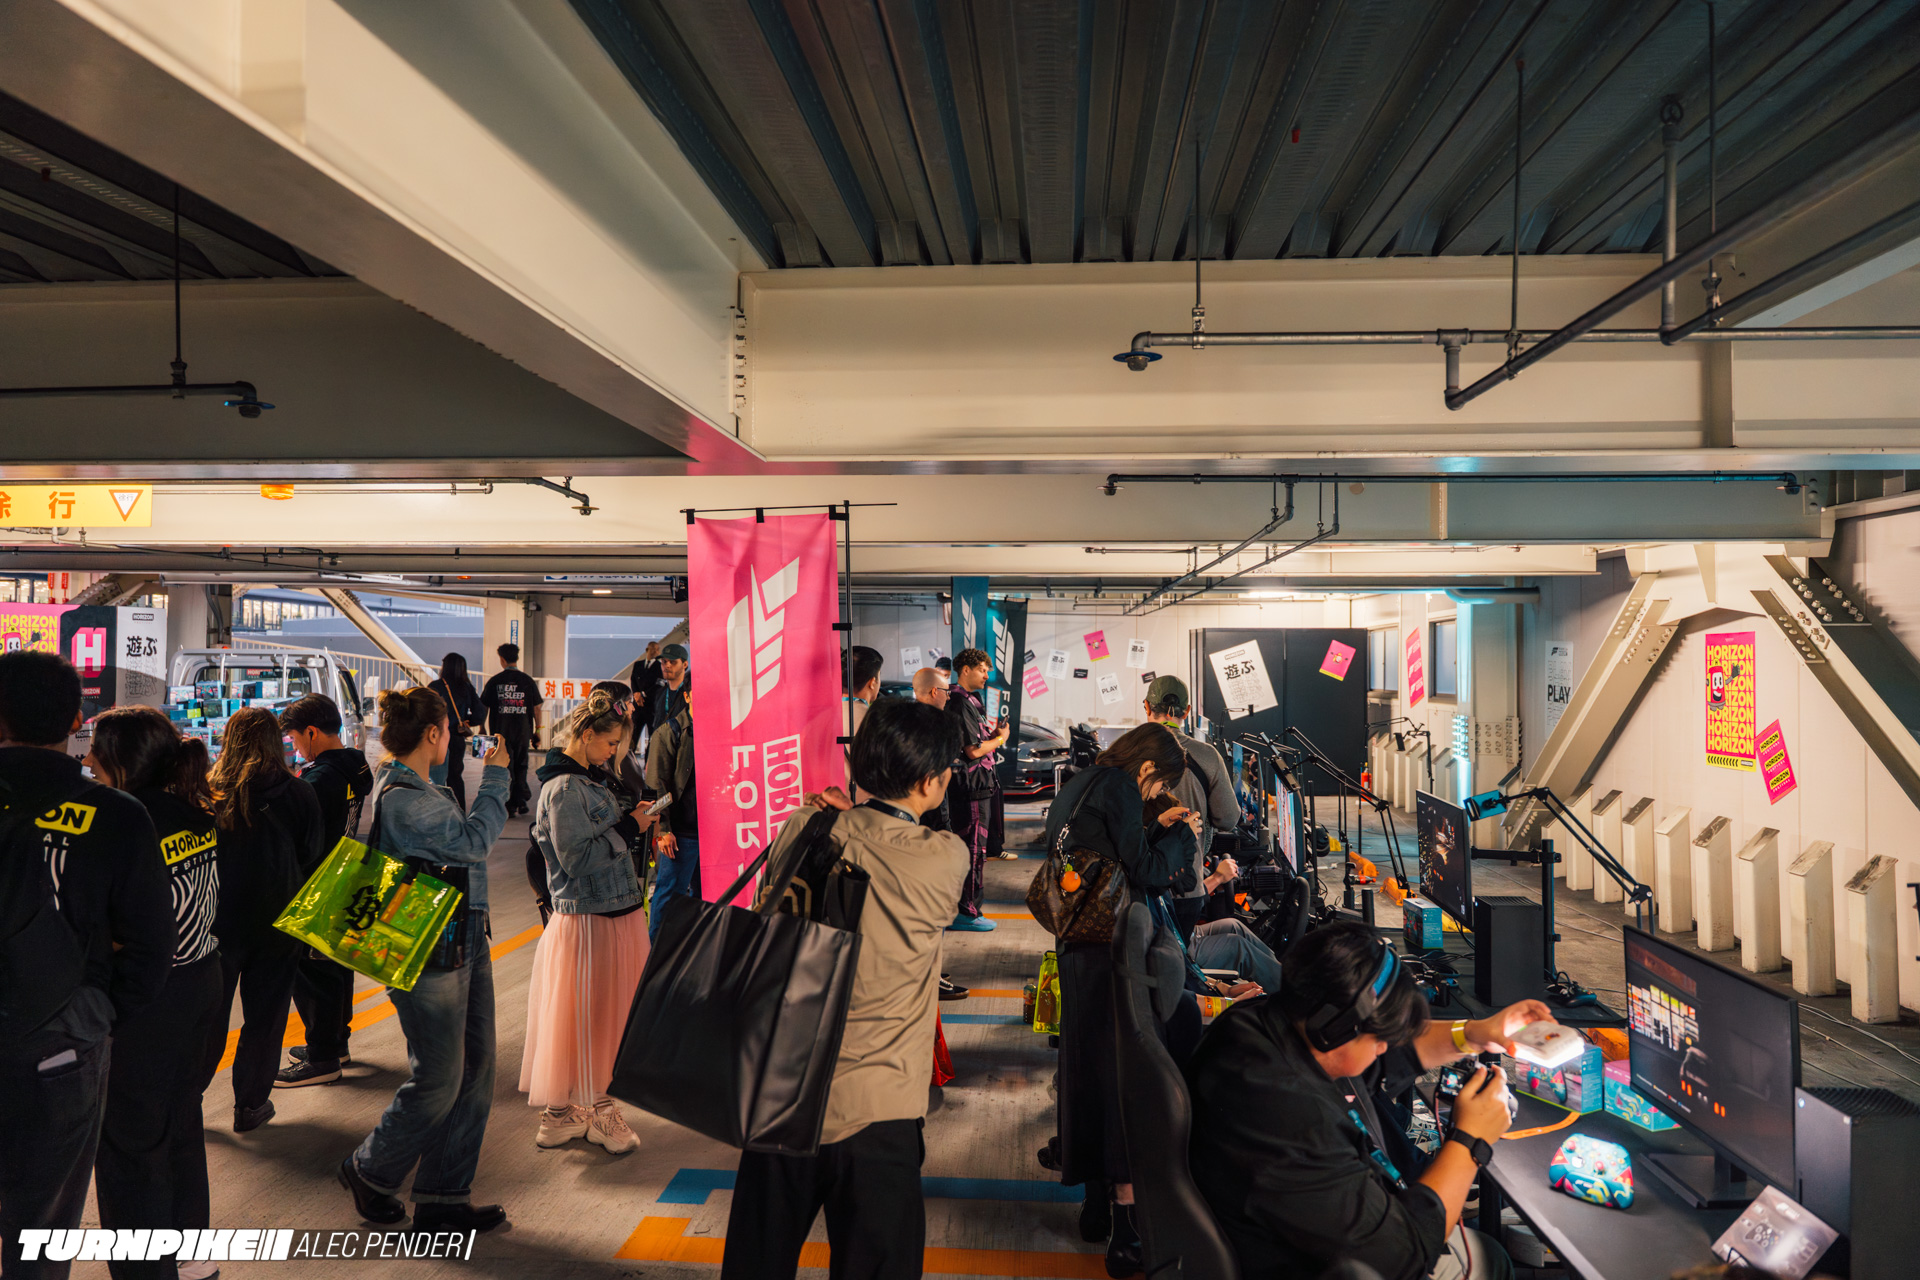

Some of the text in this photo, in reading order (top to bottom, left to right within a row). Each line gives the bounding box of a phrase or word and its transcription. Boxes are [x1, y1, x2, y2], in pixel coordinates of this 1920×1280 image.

[1, 614, 58, 628] HORIZON
[126, 635, 157, 657] 遊ぶ
[1707, 644, 1753, 660] HORIZON
[1224, 659, 1255, 680] 遊ぶ
[504, 684, 518, 692] EAT
[545, 680, 593, 699] 対向車
[1101, 684, 1118, 694] PLAY
[1547, 684, 1571, 704] PLAY
[1708, 706, 1754, 722] HORIZON
[1708, 720, 1754, 739] HORIZON
[1707, 736, 1754, 755] HORIZON
[1761, 732, 1779, 751] HORIZON
[1765, 751, 1784, 769] HORIZON
[1770, 769, 1789, 787] HORIZON
